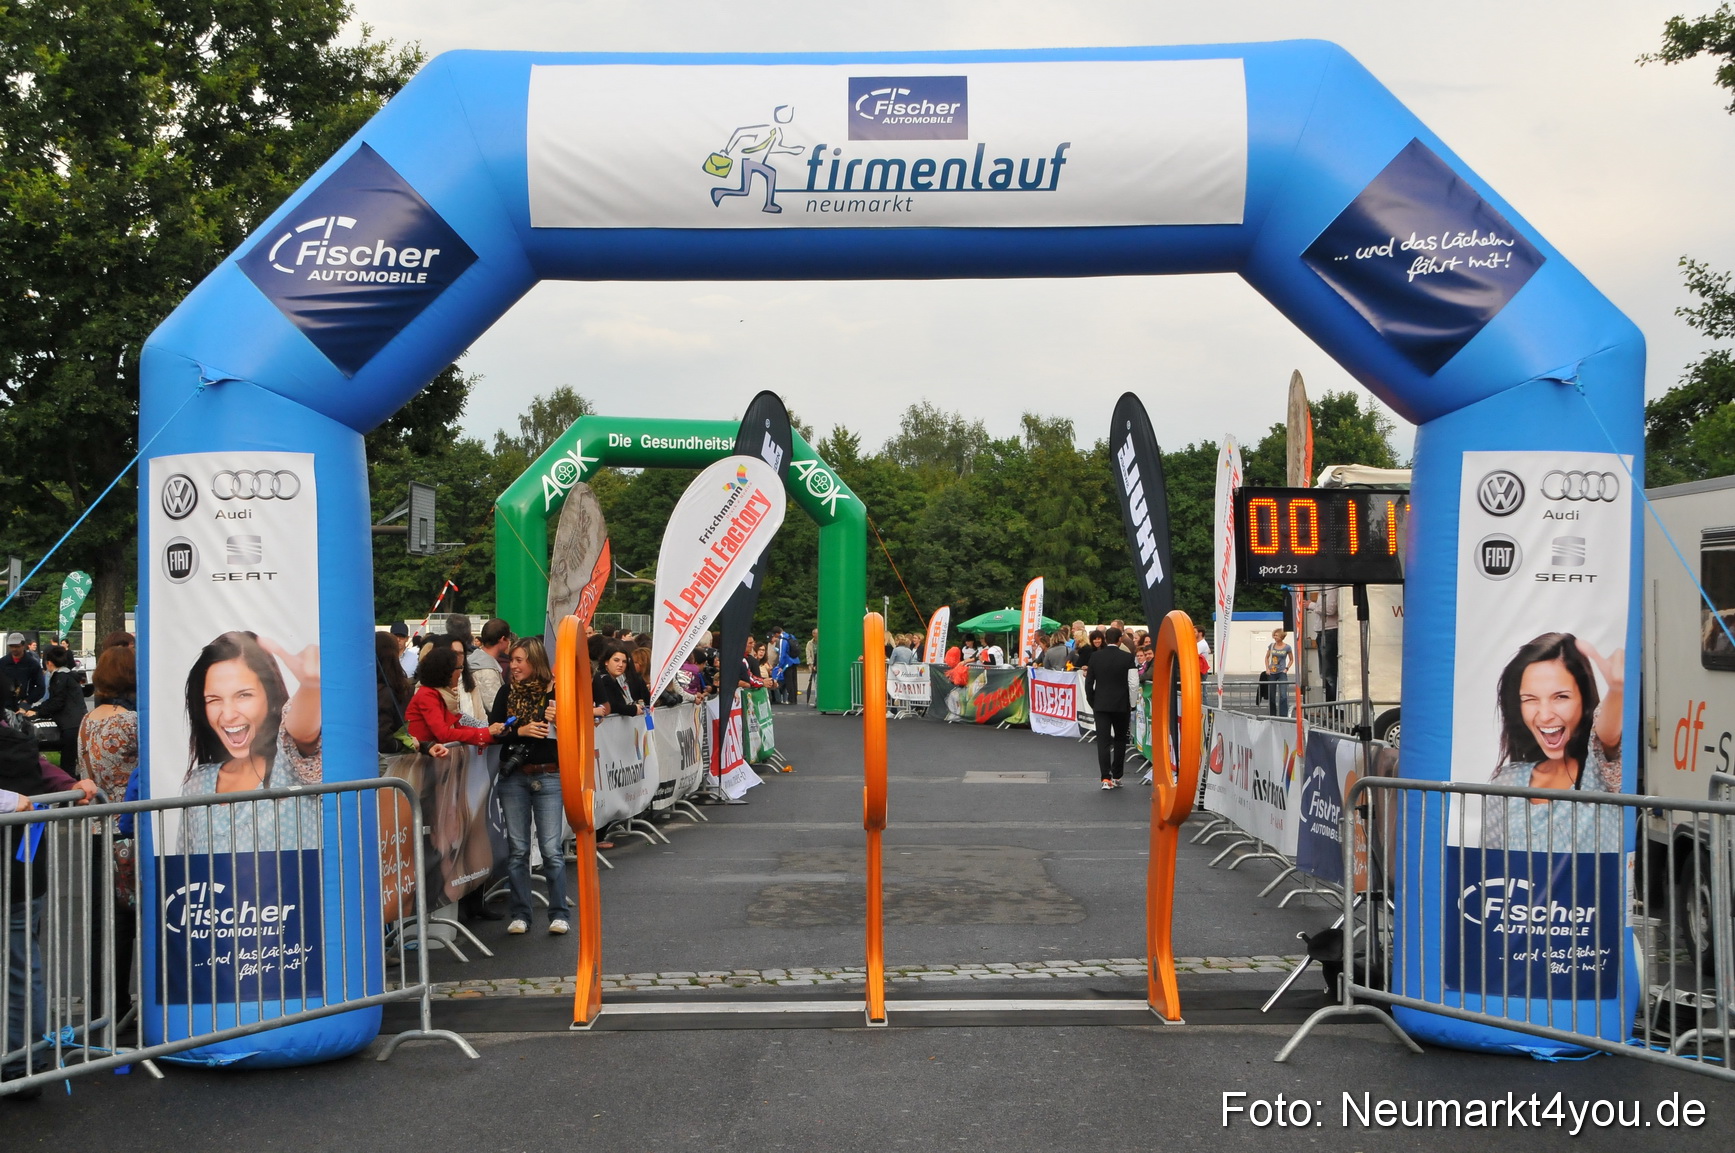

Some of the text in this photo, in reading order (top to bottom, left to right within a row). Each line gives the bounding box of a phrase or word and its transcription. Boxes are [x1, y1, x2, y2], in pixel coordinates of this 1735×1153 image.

[874, 100, 961, 116] Fischer
[882, 116, 954, 125] AUTOMOBILE
[806, 142, 1071, 192] firmenlauf
[805, 195, 914, 213] neumarkt
[295, 239, 440, 268] Fischer
[1355, 237, 1395, 260] und
[1400, 232, 1437, 251] das
[307, 270, 428, 284] AUTOMOBILE
[1406, 251, 1512, 283] fährt mit!
[608, 433, 632, 448] Die
[541, 439, 600, 512] AOK
[789, 459, 851, 517] AOK
[215, 509, 252, 520] Audi
[698, 485, 743, 545] Frischmann
[1542, 510, 1579, 521] Audi
[680, 557, 723, 609] Print
[710, 488, 772, 563] Factory
[1485, 547, 1513, 568] FIAT
[169, 550, 190, 572] FIAT
[1258, 565, 1298, 575] sport 23
[211, 572, 278, 582] SEAT
[1535, 573, 1598, 583] SEAT
[1034, 683, 1073, 718] MEIER
[180, 901, 296, 926] Fischer
[1484, 897, 1596, 923] Fischer
